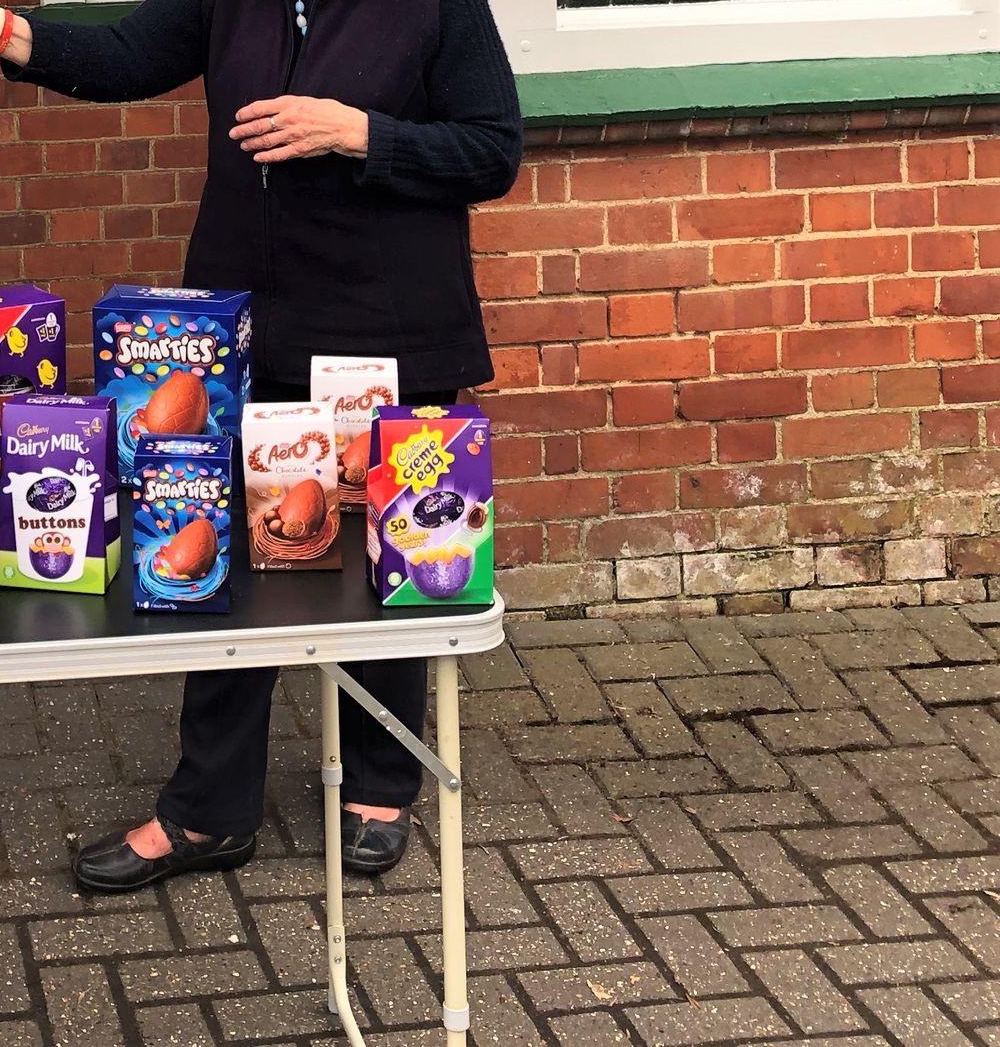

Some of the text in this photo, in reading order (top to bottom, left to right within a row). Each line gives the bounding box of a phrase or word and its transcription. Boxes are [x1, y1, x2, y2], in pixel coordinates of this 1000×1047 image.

[26, 397, 90, 406] Dairy Milk
[17, 423, 49, 438] Cadbury
[6, 433, 90, 458] Dairy Milk
[403, 440, 438, 480] creme
[416, 455, 444, 482] egg
[17, 516, 86, 530] buttons
[390, 518, 408, 532] 50
